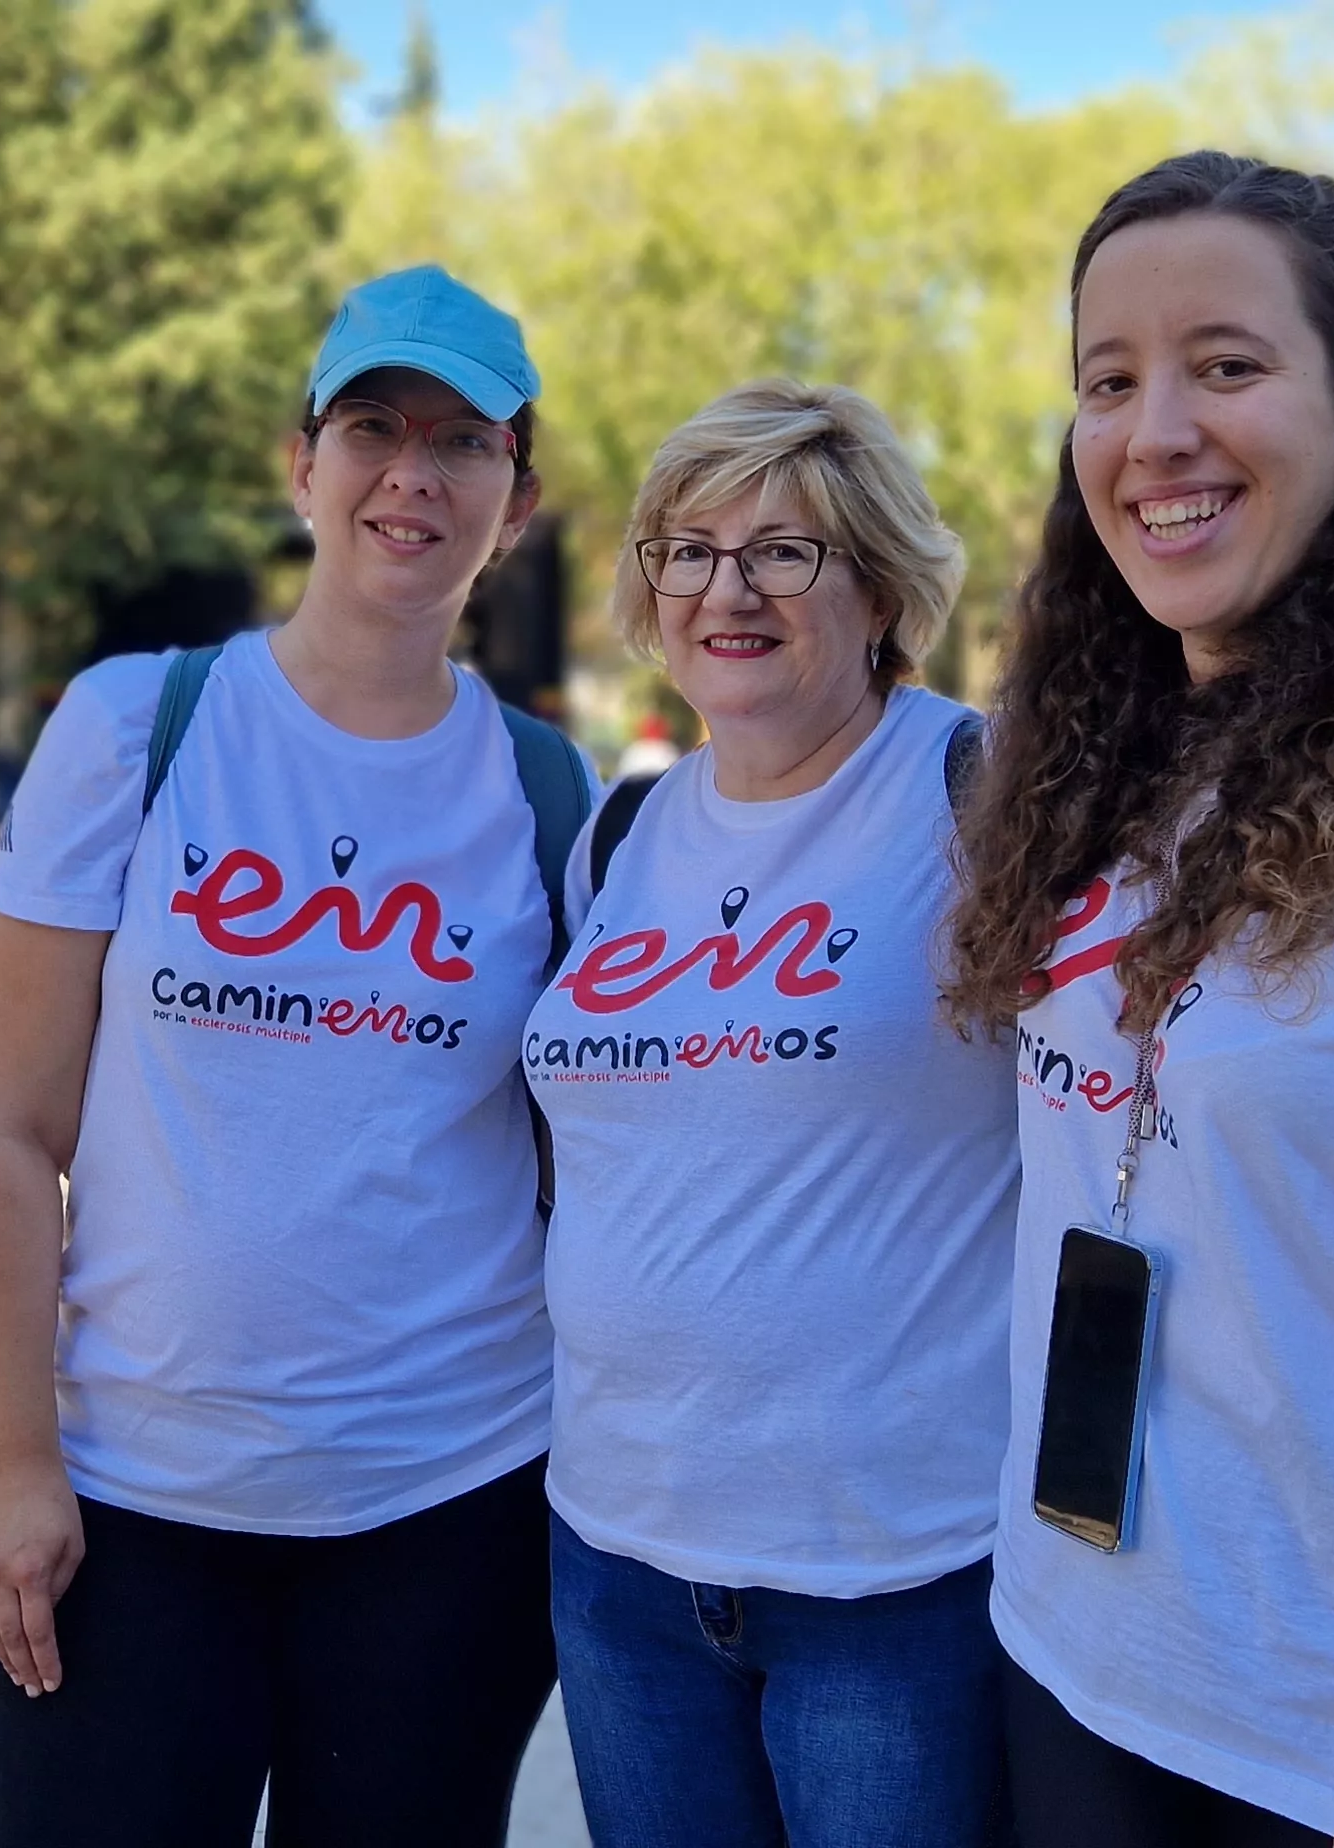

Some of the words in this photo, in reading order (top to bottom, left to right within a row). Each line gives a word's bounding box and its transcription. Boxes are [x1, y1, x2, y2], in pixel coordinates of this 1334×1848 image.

[153, 1009, 173, 1020] por
[175, 1011, 186, 1023] la
[191, 1016, 251, 1034] esclerosis
[255, 1026, 311, 1044] múltiple
[617, 1071, 670, 1083] múltiple
